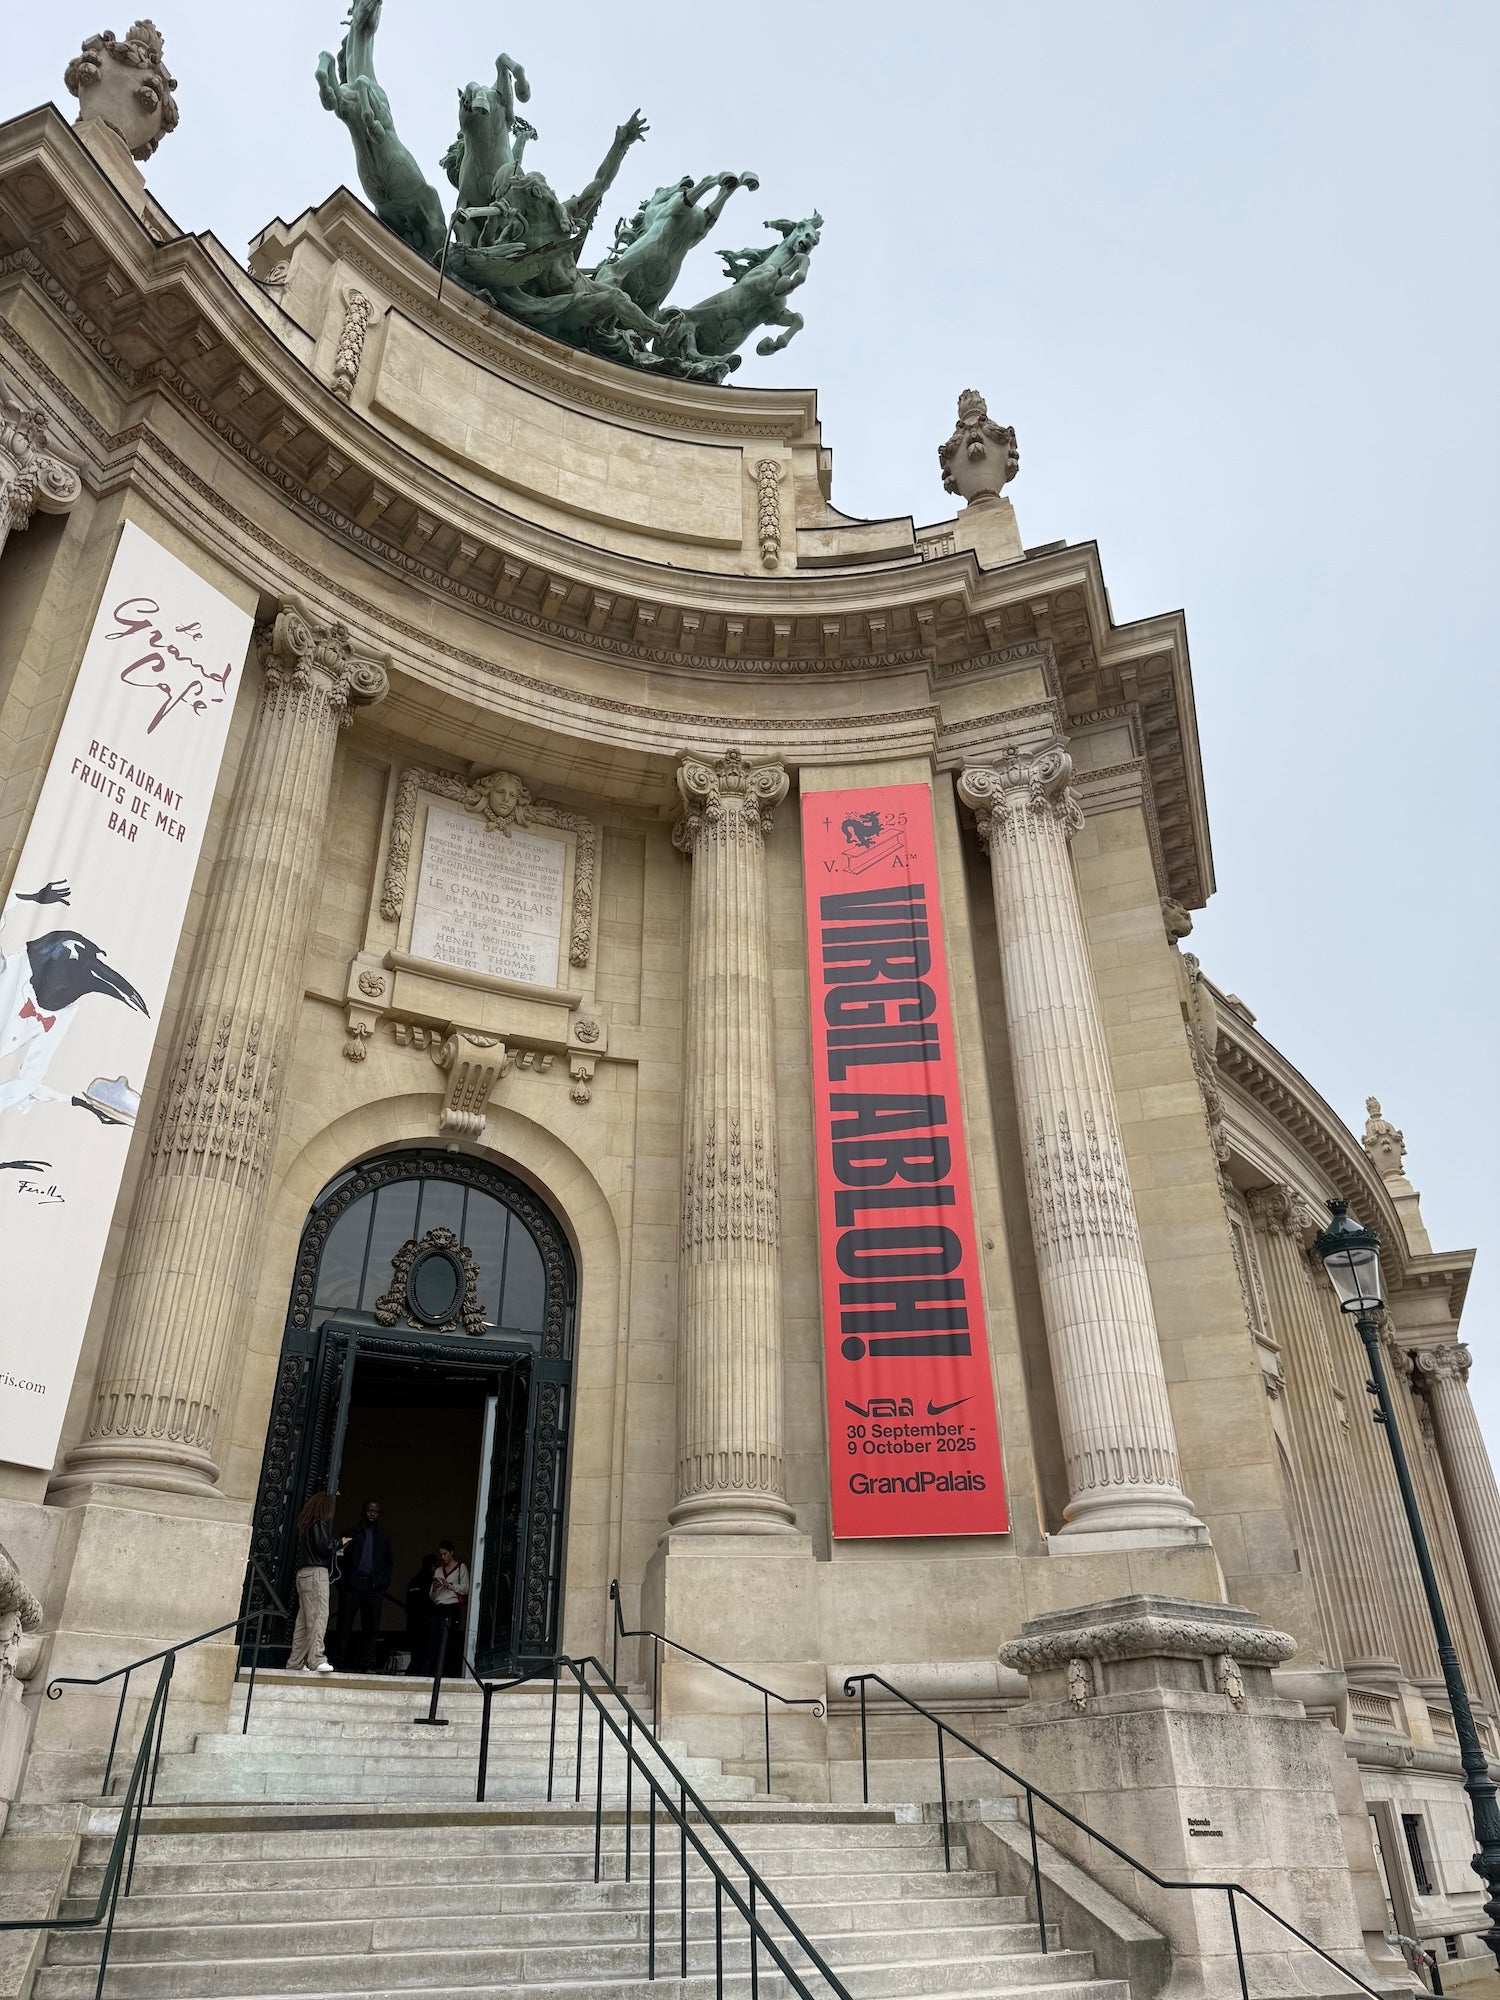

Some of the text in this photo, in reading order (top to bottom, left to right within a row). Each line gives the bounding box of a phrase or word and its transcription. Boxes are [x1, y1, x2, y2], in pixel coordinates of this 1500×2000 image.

[105, 597, 231, 695] Grand
[121, 652, 224, 735] Café
[88, 739, 184, 812] RESTAURANT
[70, 757, 187, 843] FRUITS DE MER
[108, 811, 139, 843] BAR
[885, 812, 908, 826] 25
[479, 840, 541, 862] BOUVARD
[447, 860, 484, 876] GIRAULT
[429, 876, 553, 917] LE GRAND PALAIS
[446, 894, 464, 904] DES
[468, 920, 489, 930] 1897
[502, 928, 522, 938] 1900
[482, 916, 524, 930] CONSTRUIT
[436, 933, 535, 962] HENRI DEGLANE
[441, 924, 530, 951] PAR LES ARCHITECTES
[432, 942, 536, 971] ALBERT THOMAS
[433, 952, 534, 981] ALBERT LOUVET
[819, 883, 972, 1362] VIRGIL ABLOH!
[847, 1424, 866, 1438] 30
[871, 1422, 964, 1440] September
[847, 1438, 976, 1455] 9 October 2025
[849, 1470, 986, 1494] GrandPalais
